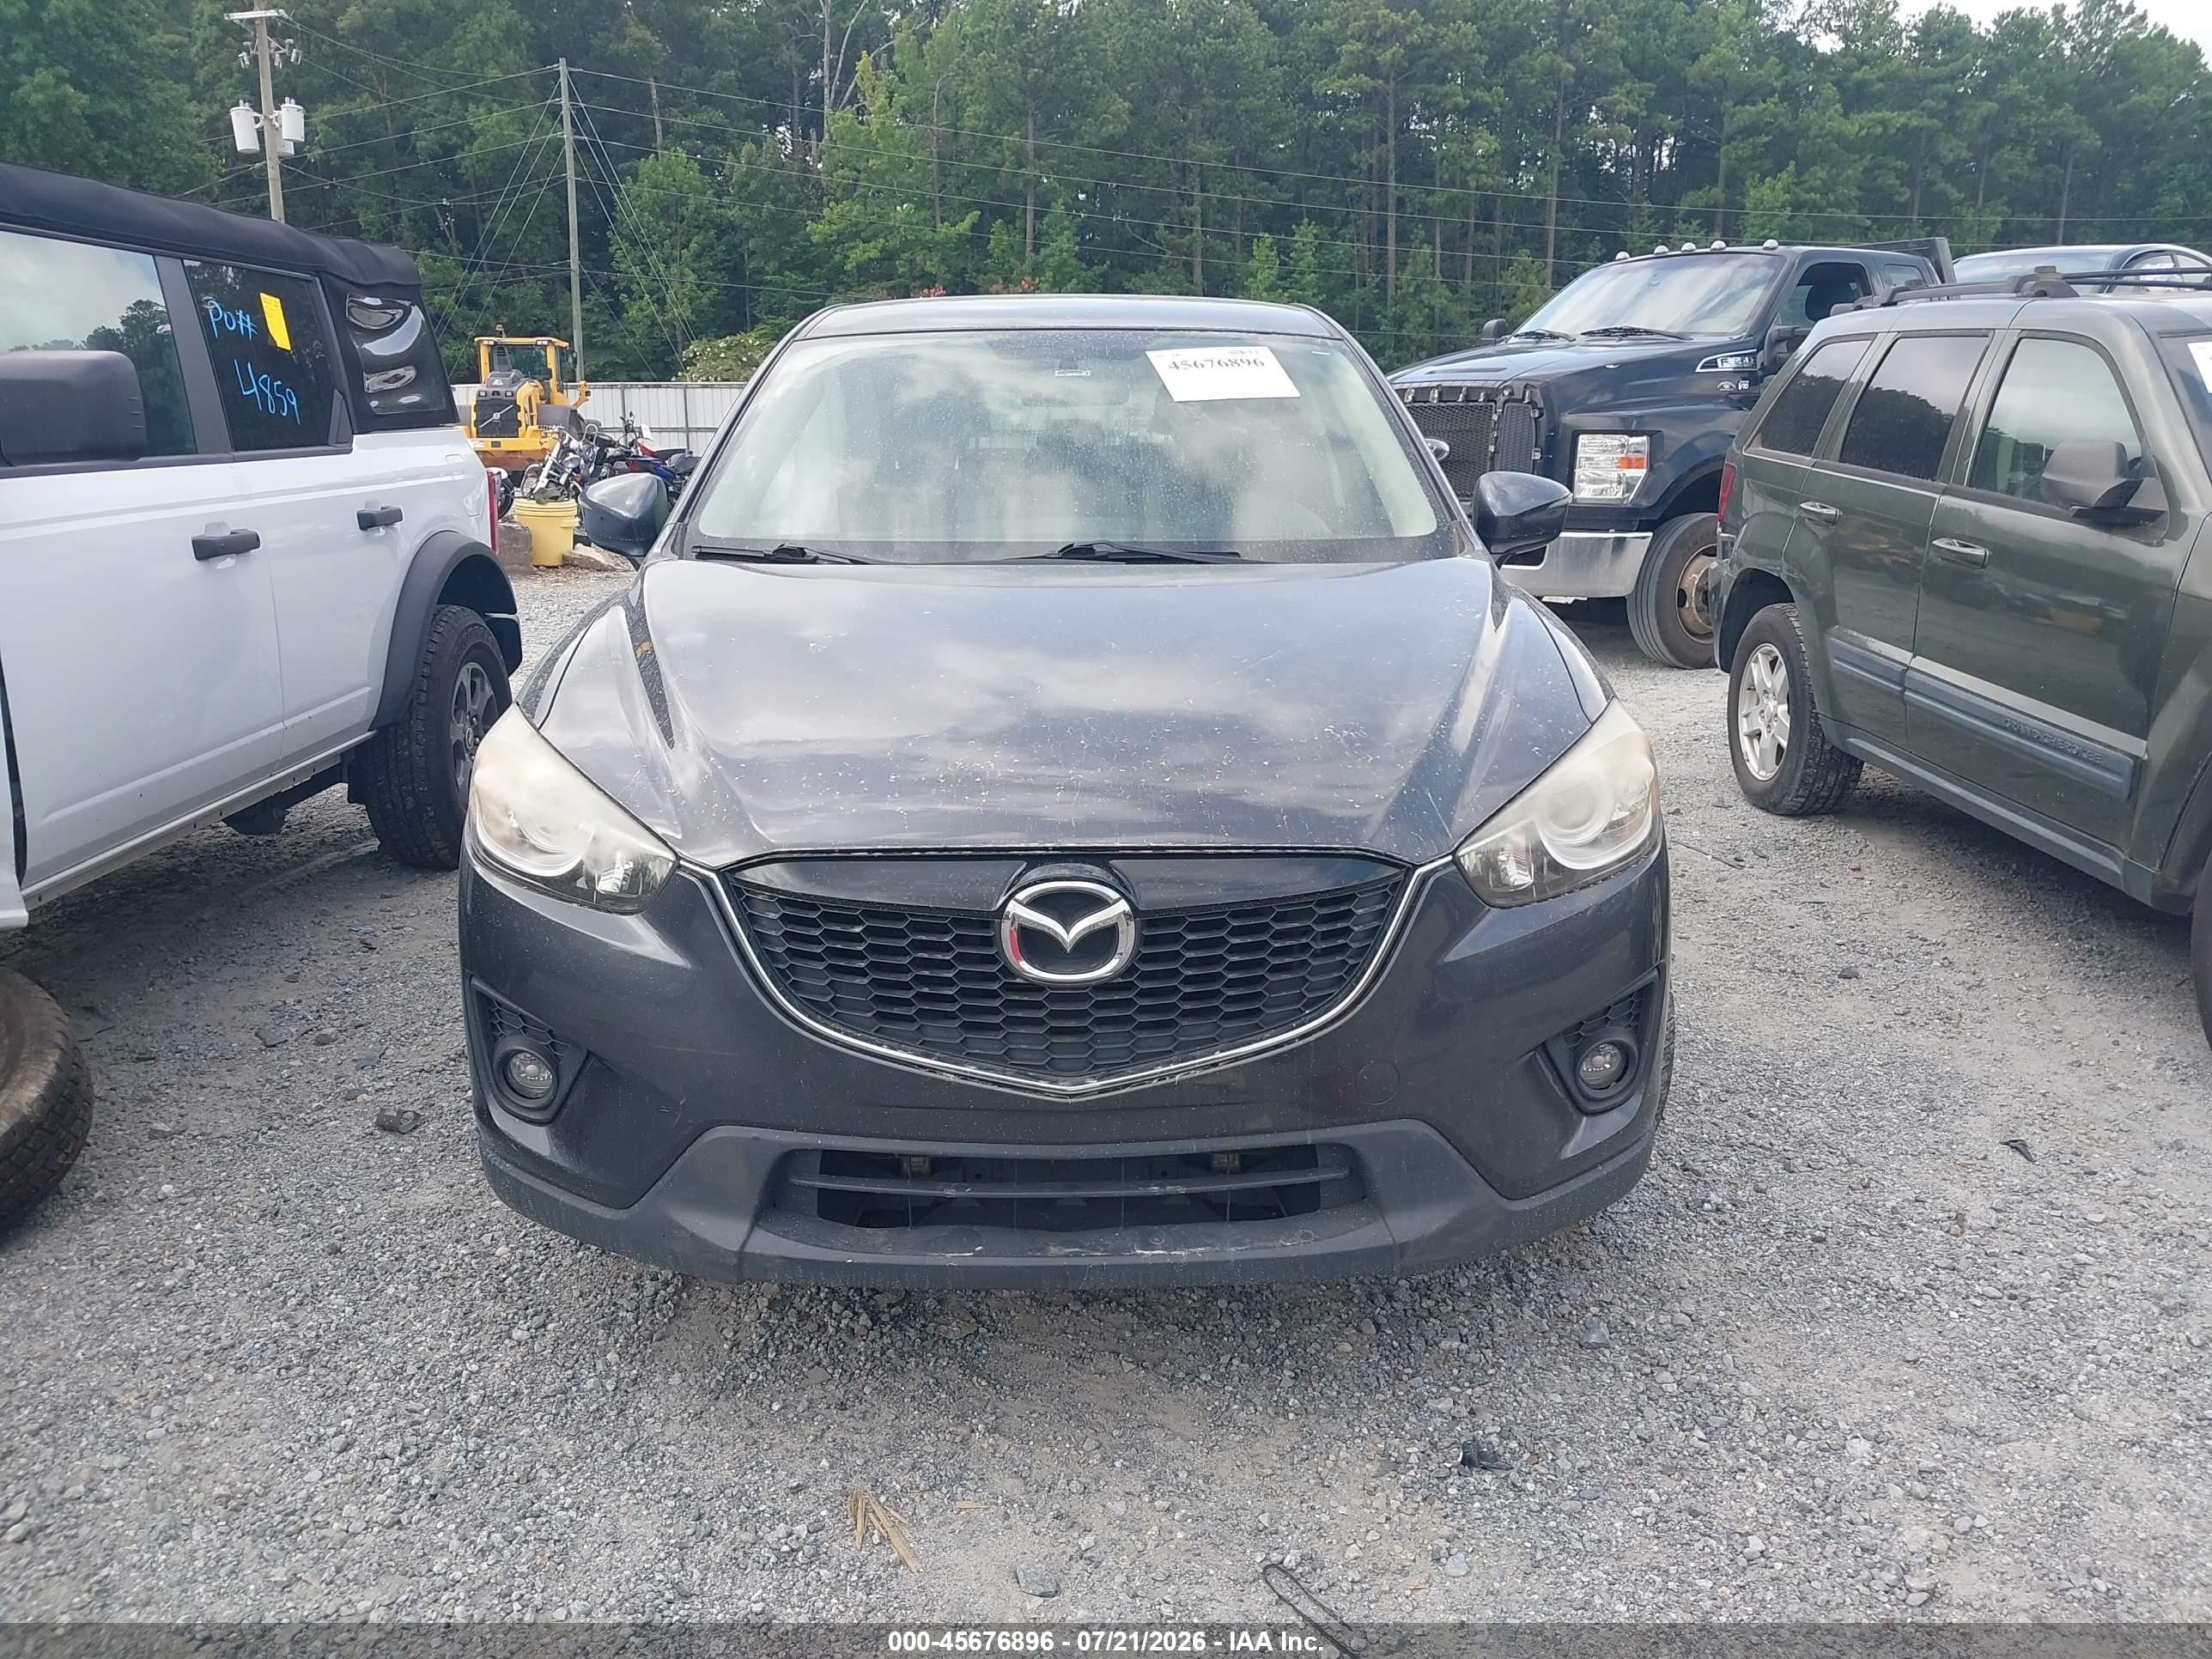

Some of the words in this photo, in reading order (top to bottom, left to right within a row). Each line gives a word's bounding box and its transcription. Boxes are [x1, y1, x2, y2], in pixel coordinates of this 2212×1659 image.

[1169, 358, 1265, 370] 45676896
[234, 359, 300, 425] 4859
[2005, 718, 2040, 740] GRAND
[2042, 732, 2102, 763] CHEROKEE
